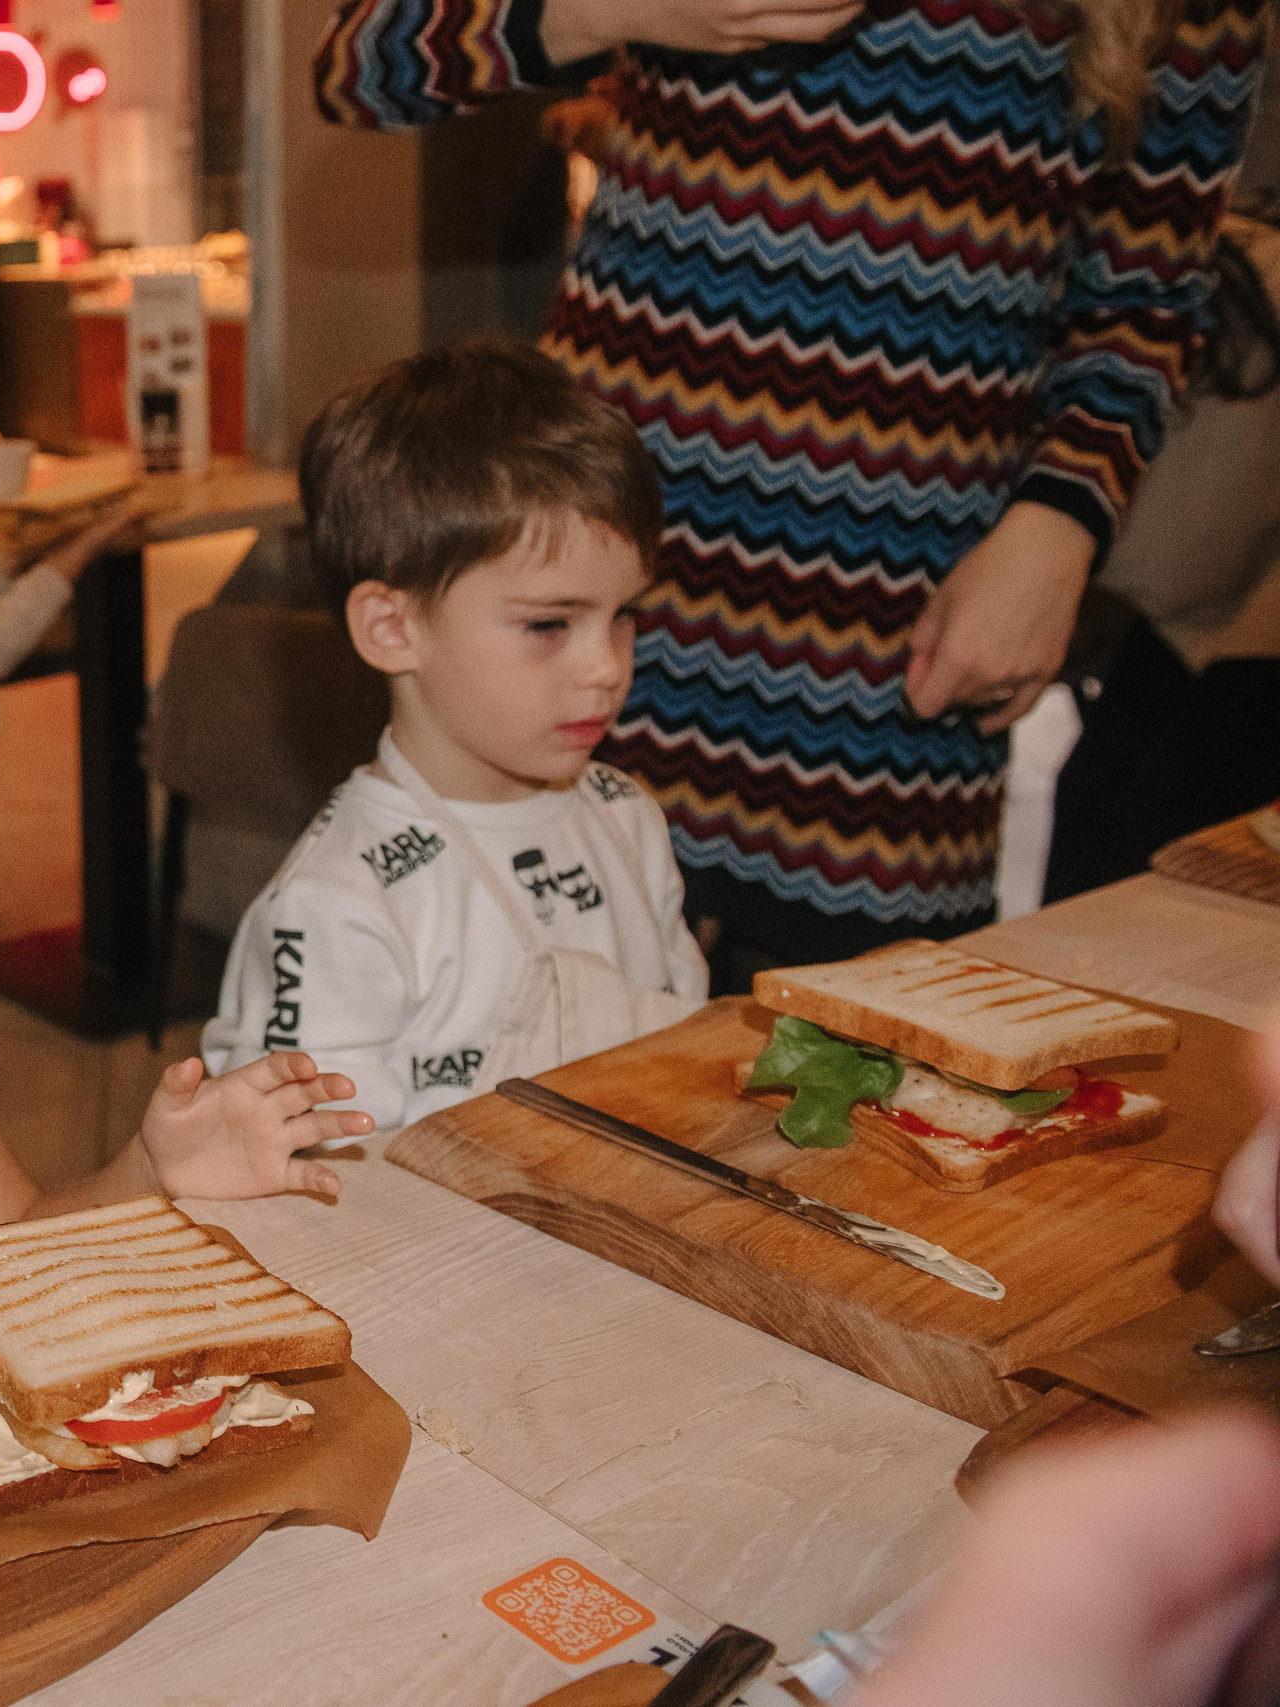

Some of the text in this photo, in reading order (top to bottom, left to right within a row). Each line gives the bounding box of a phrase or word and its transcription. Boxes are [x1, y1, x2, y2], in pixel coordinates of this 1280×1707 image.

[360, 825, 437, 879] KARL
[264, 929, 303, 1052] KARL
[412, 1047, 484, 1082] KAR
